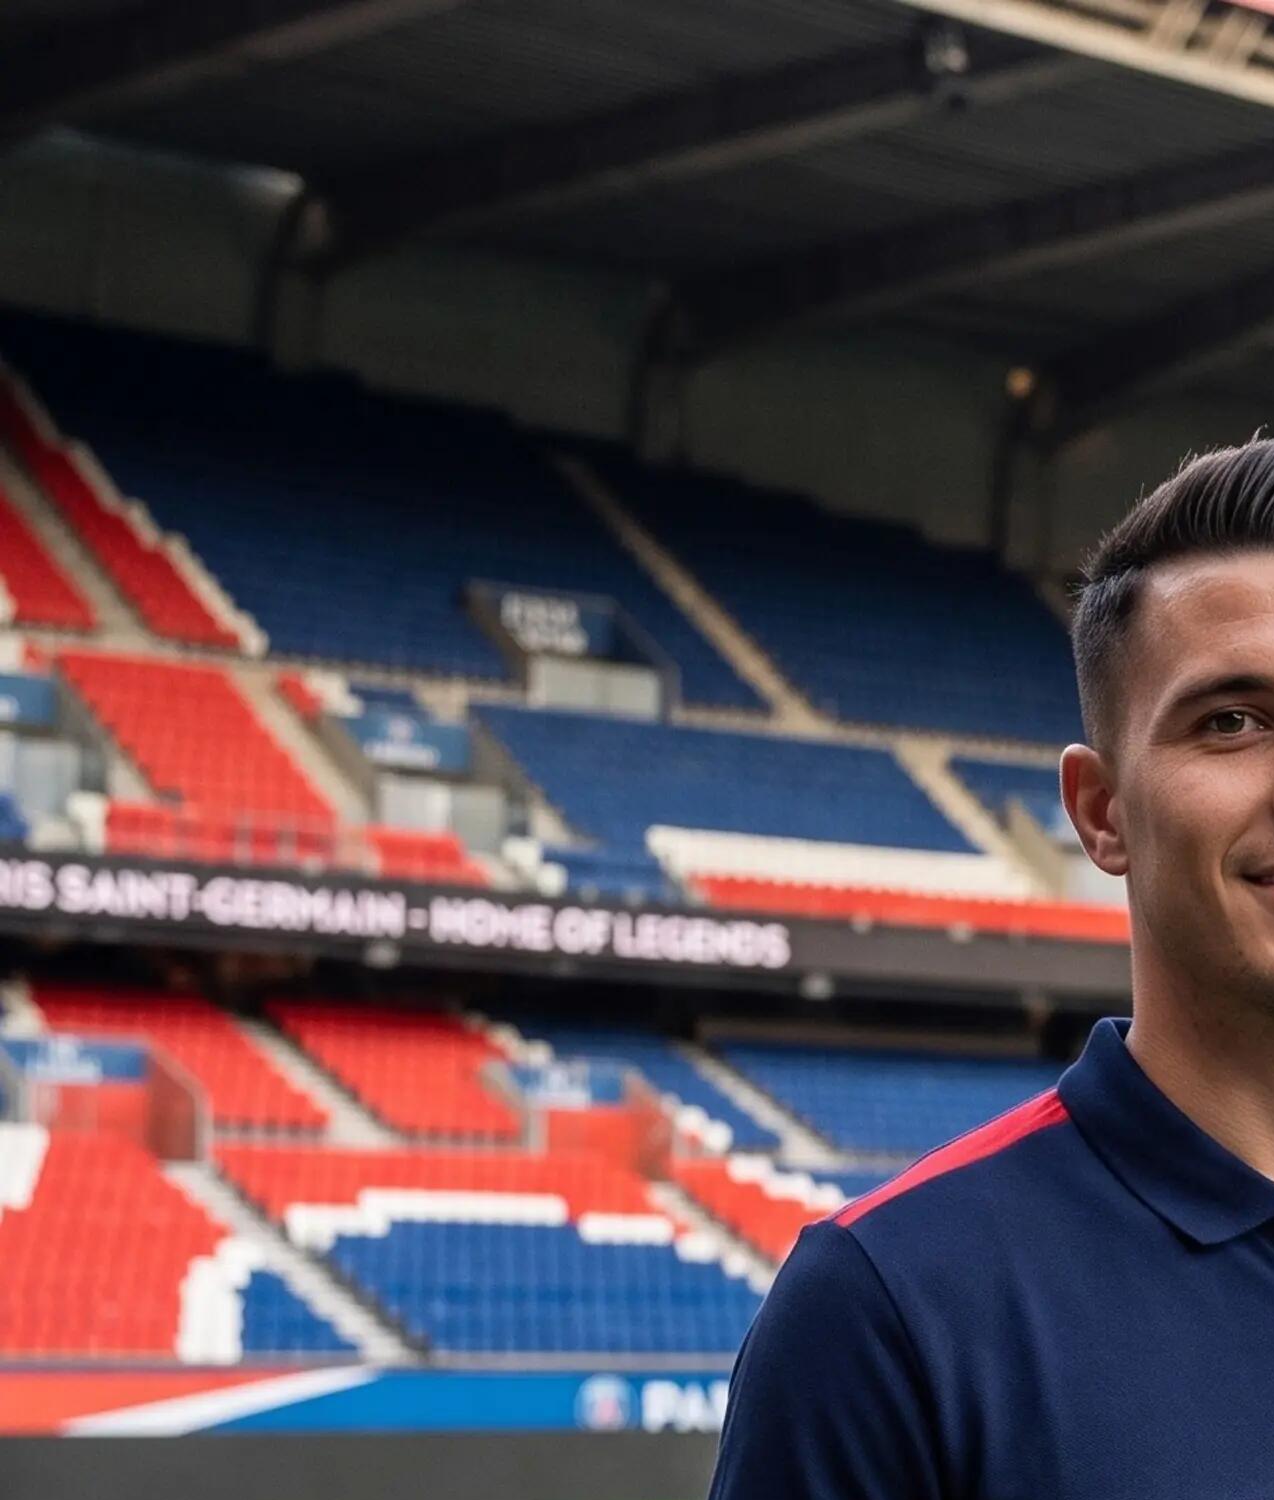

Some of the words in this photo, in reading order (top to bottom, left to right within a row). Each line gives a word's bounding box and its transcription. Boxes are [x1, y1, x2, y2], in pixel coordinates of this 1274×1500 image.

[429, 896, 554, 952] HOME
[554, 906, 612, 955] OF
[613, 911, 792, 969] LEGENDS
